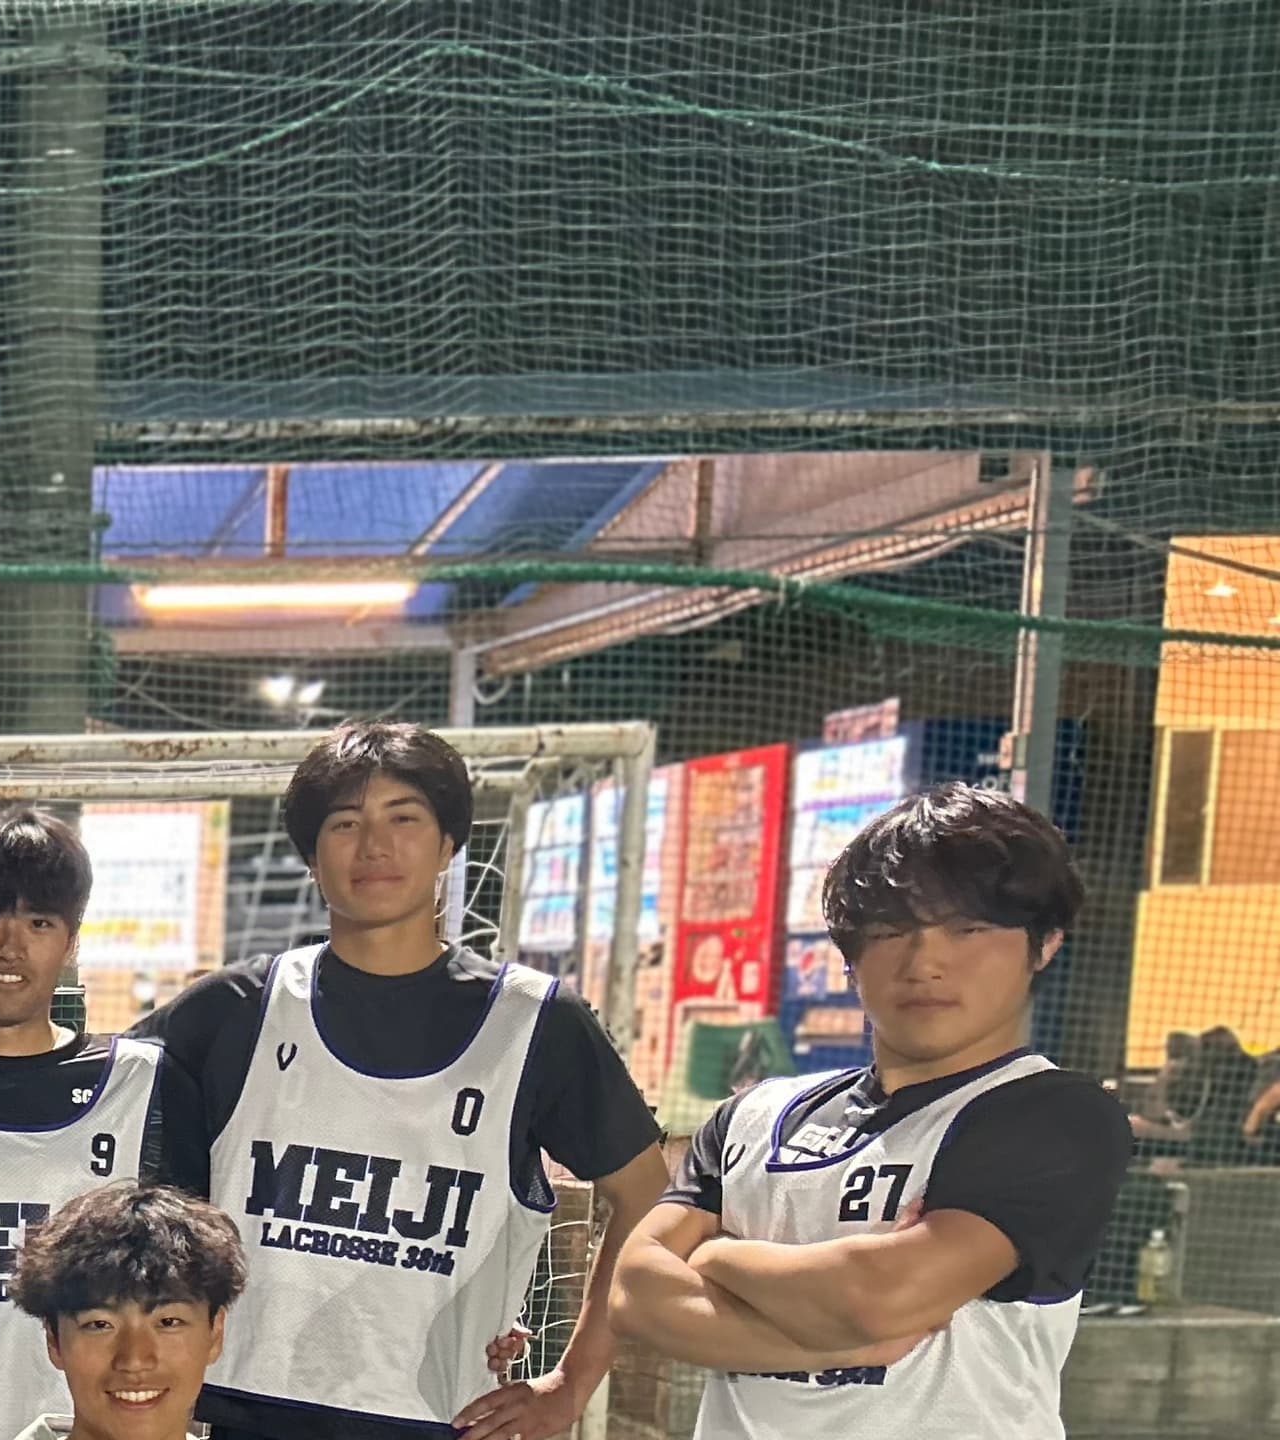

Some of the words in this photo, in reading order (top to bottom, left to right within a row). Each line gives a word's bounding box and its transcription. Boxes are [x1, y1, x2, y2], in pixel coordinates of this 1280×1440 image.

[90, 1133, 116, 1177] 9
[245, 1140, 485, 1248] MEIJI
[838, 1164, 914, 1221] 27
[260, 1222, 400, 1267] LACROSSE
